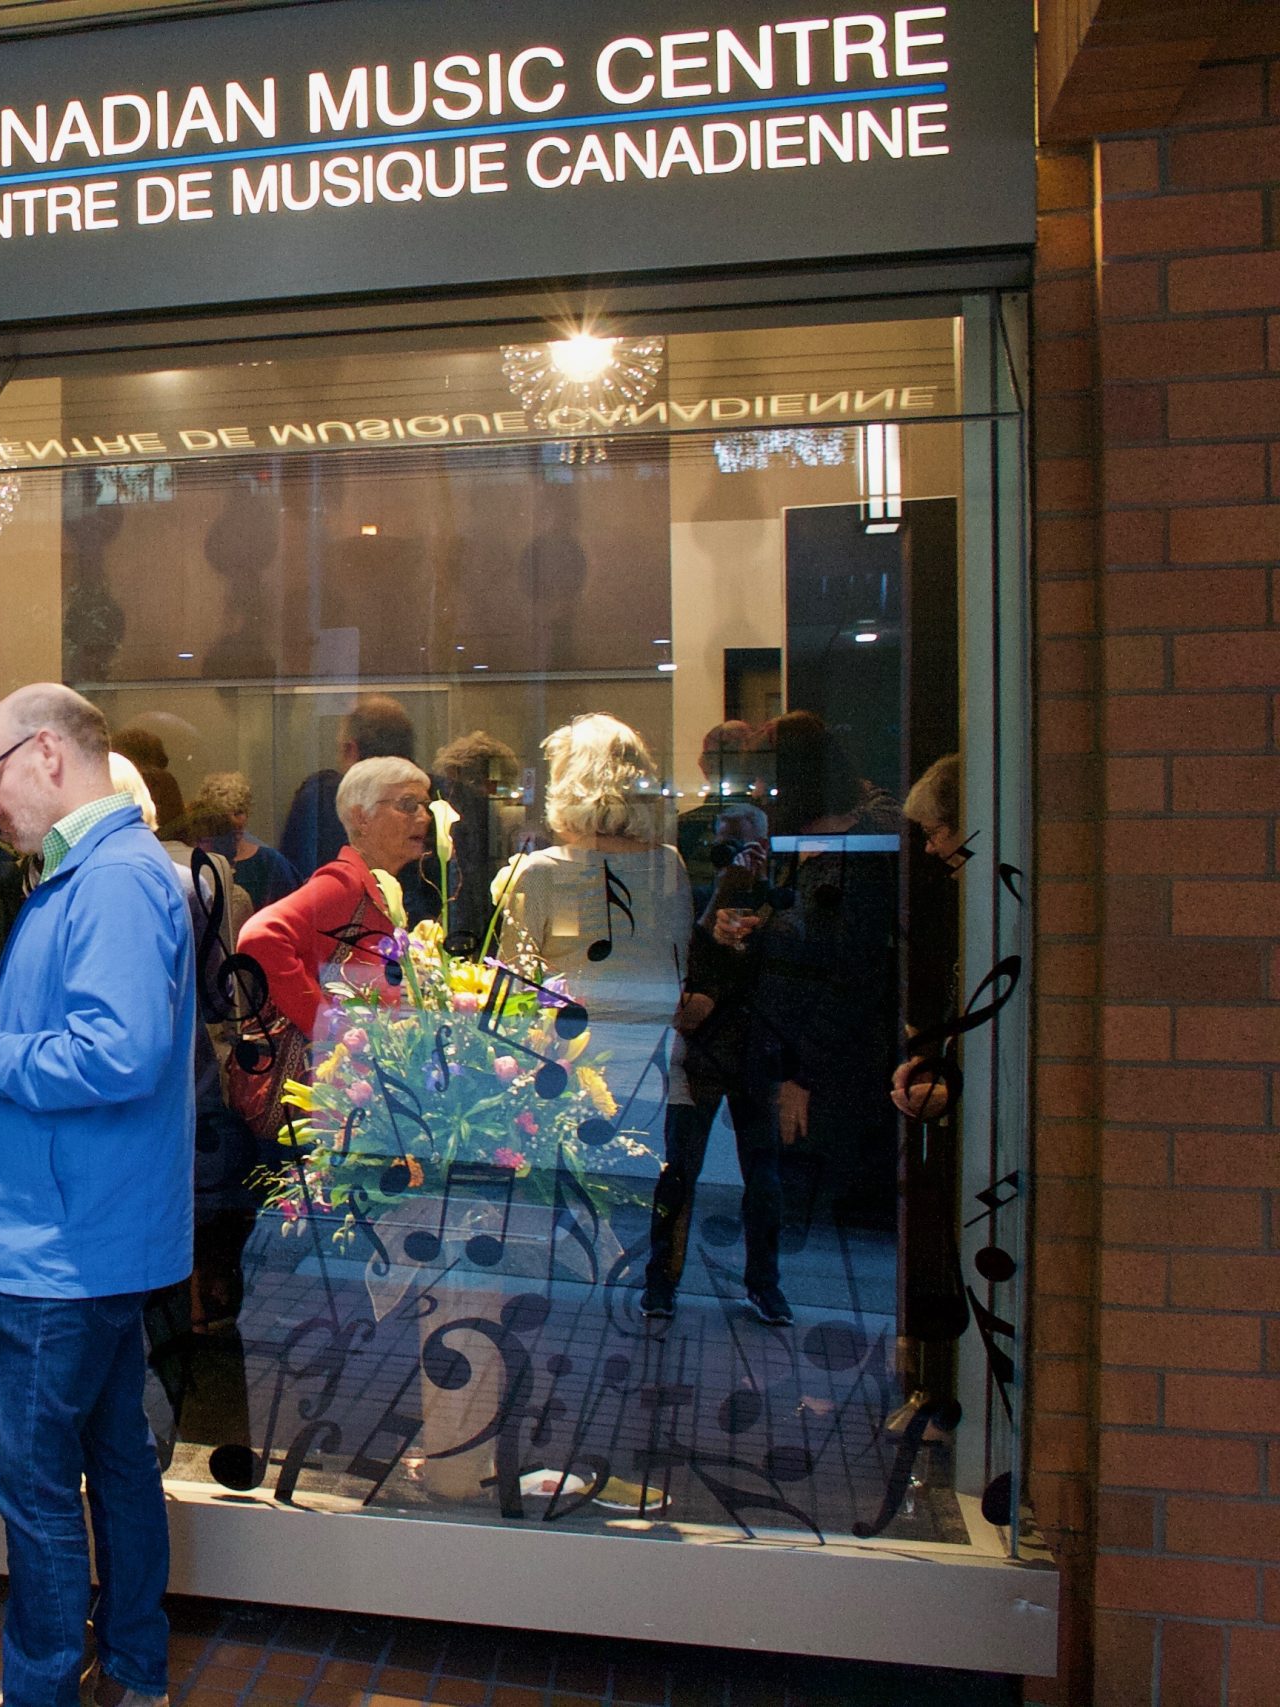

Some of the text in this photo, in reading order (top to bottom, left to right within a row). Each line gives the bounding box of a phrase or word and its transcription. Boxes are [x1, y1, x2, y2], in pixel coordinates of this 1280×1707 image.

[308, 46, 566, 133] MUSIC
[596, 6, 949, 105] CENTRE
[137, 171, 214, 225] DE
[232, 142, 508, 216] MUSIQUE
[526, 103, 950, 189] CANADIENNE
